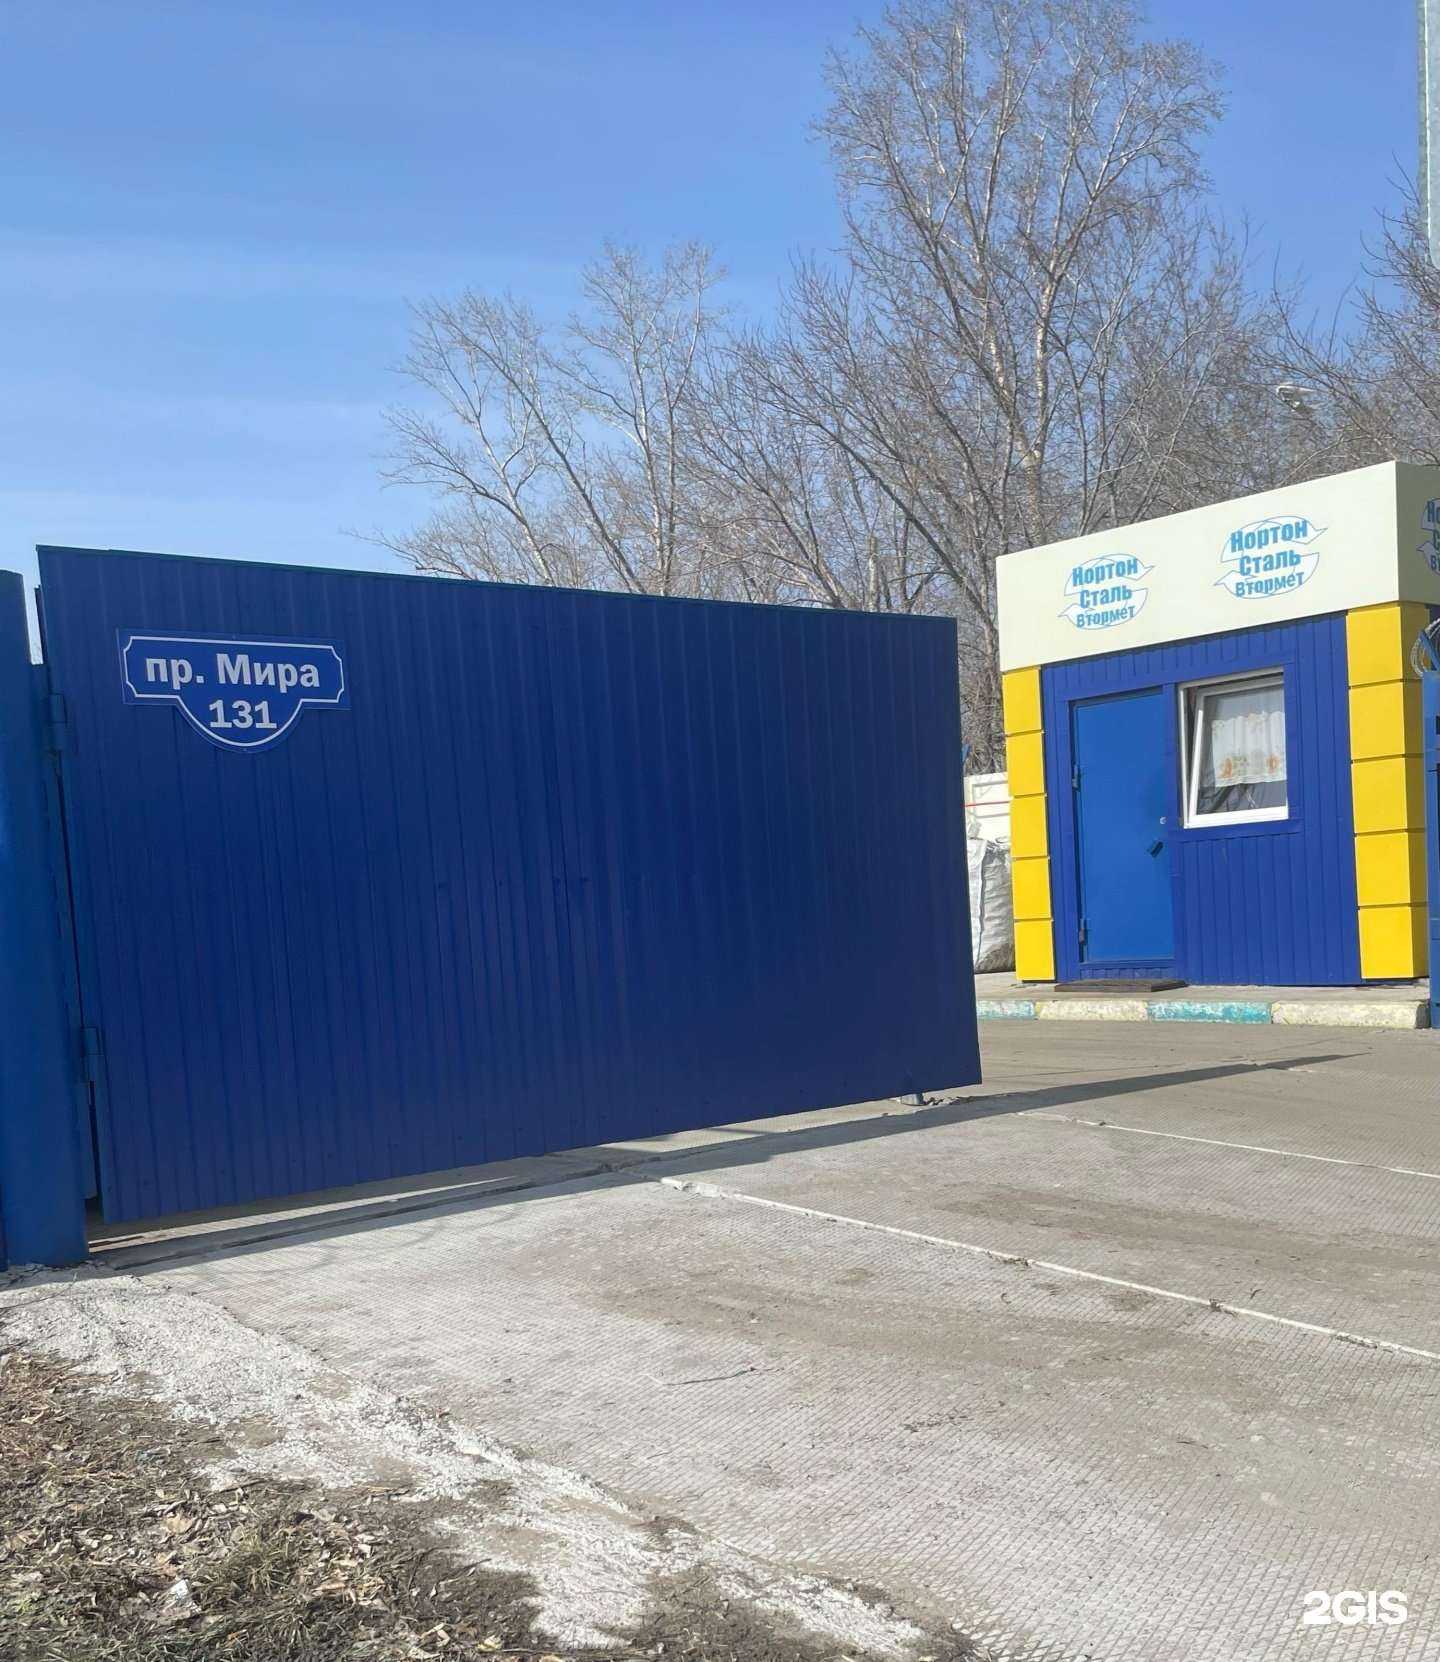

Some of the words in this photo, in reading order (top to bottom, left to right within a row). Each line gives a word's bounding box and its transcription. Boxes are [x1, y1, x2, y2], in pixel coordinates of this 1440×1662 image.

[1230, 519, 1308, 553] Нортон
[1072, 556, 1138, 587] Нортон
[1239, 549, 1301, 576] Сталь
[1079, 584, 1133, 609] Сталь
[145, 657, 205, 690] пр.
[216, 653, 320, 693] Мира
[208, 699, 277, 729] 131
